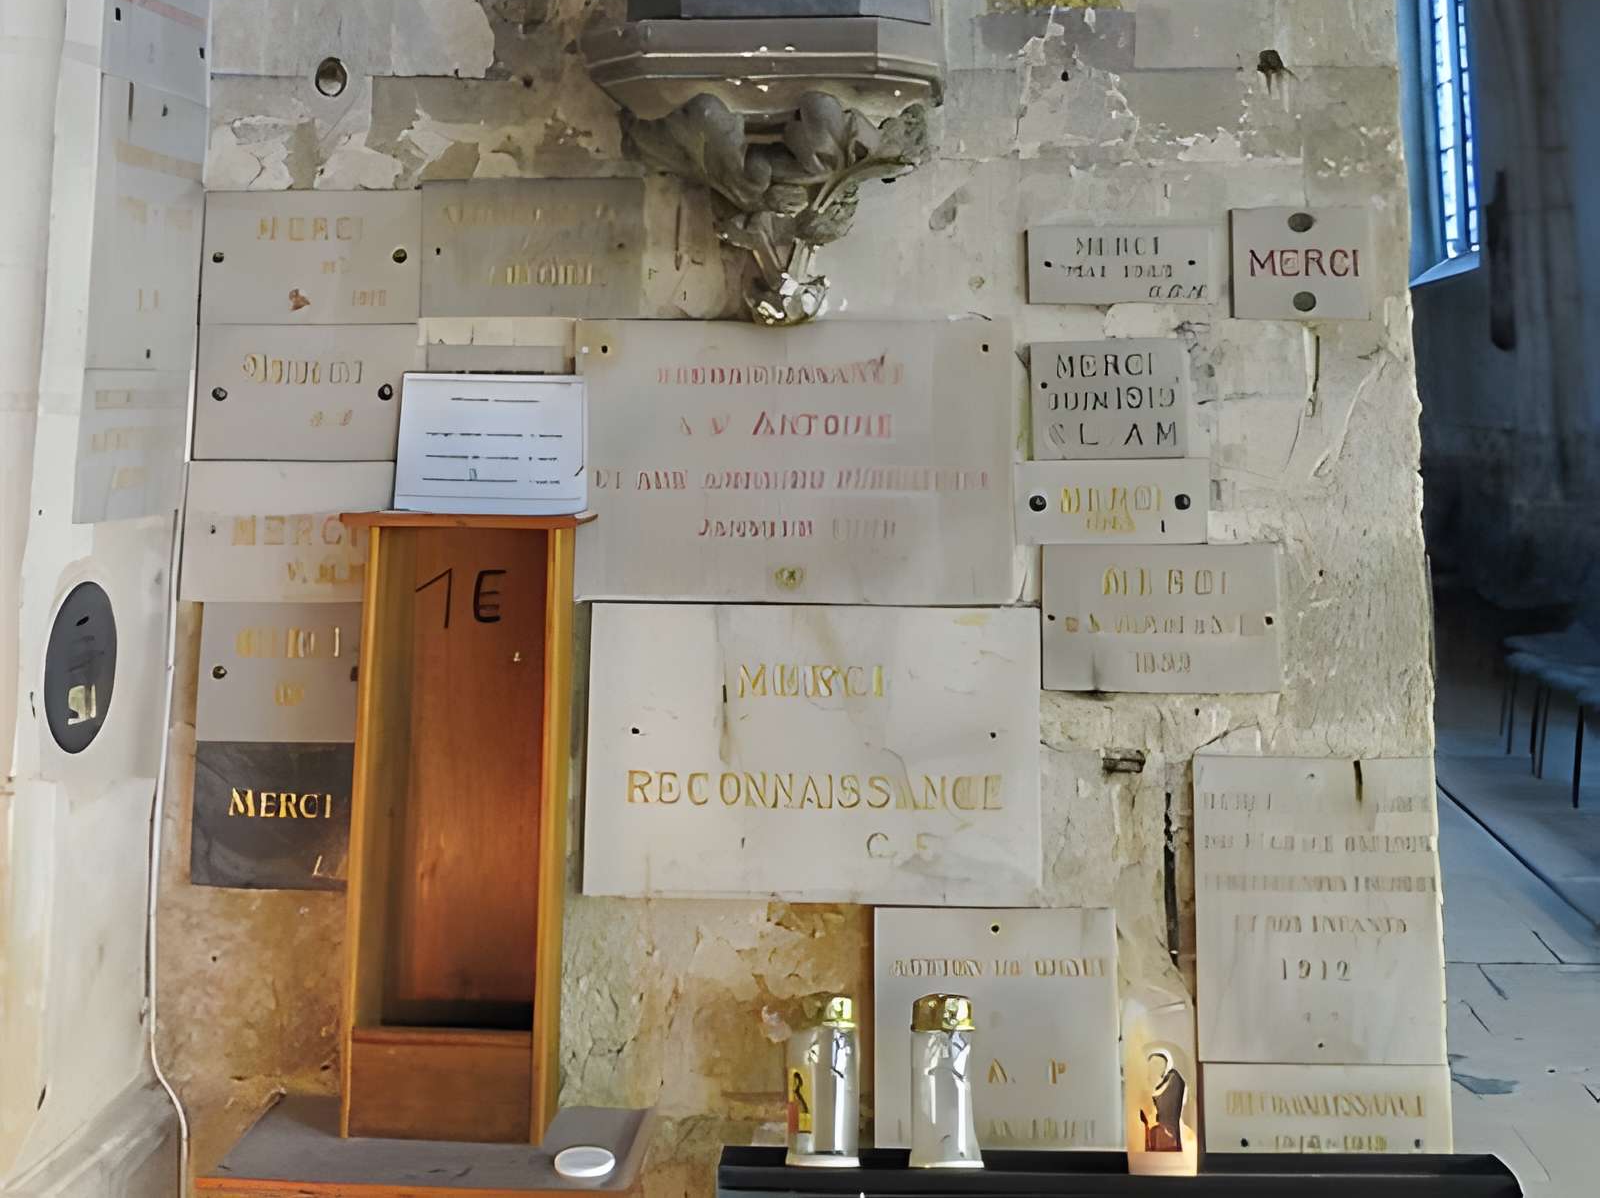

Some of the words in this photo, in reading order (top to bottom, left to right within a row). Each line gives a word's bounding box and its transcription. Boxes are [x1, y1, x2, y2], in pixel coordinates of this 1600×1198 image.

[1249, 249, 1360, 278] MERCI
[1056, 352, 1152, 378] MERCI
[228, 786, 332, 819] MERCI
[626, 768, 1004, 810] RECONNAISSANCE
[1282, 958, 1351, 982] 1912
